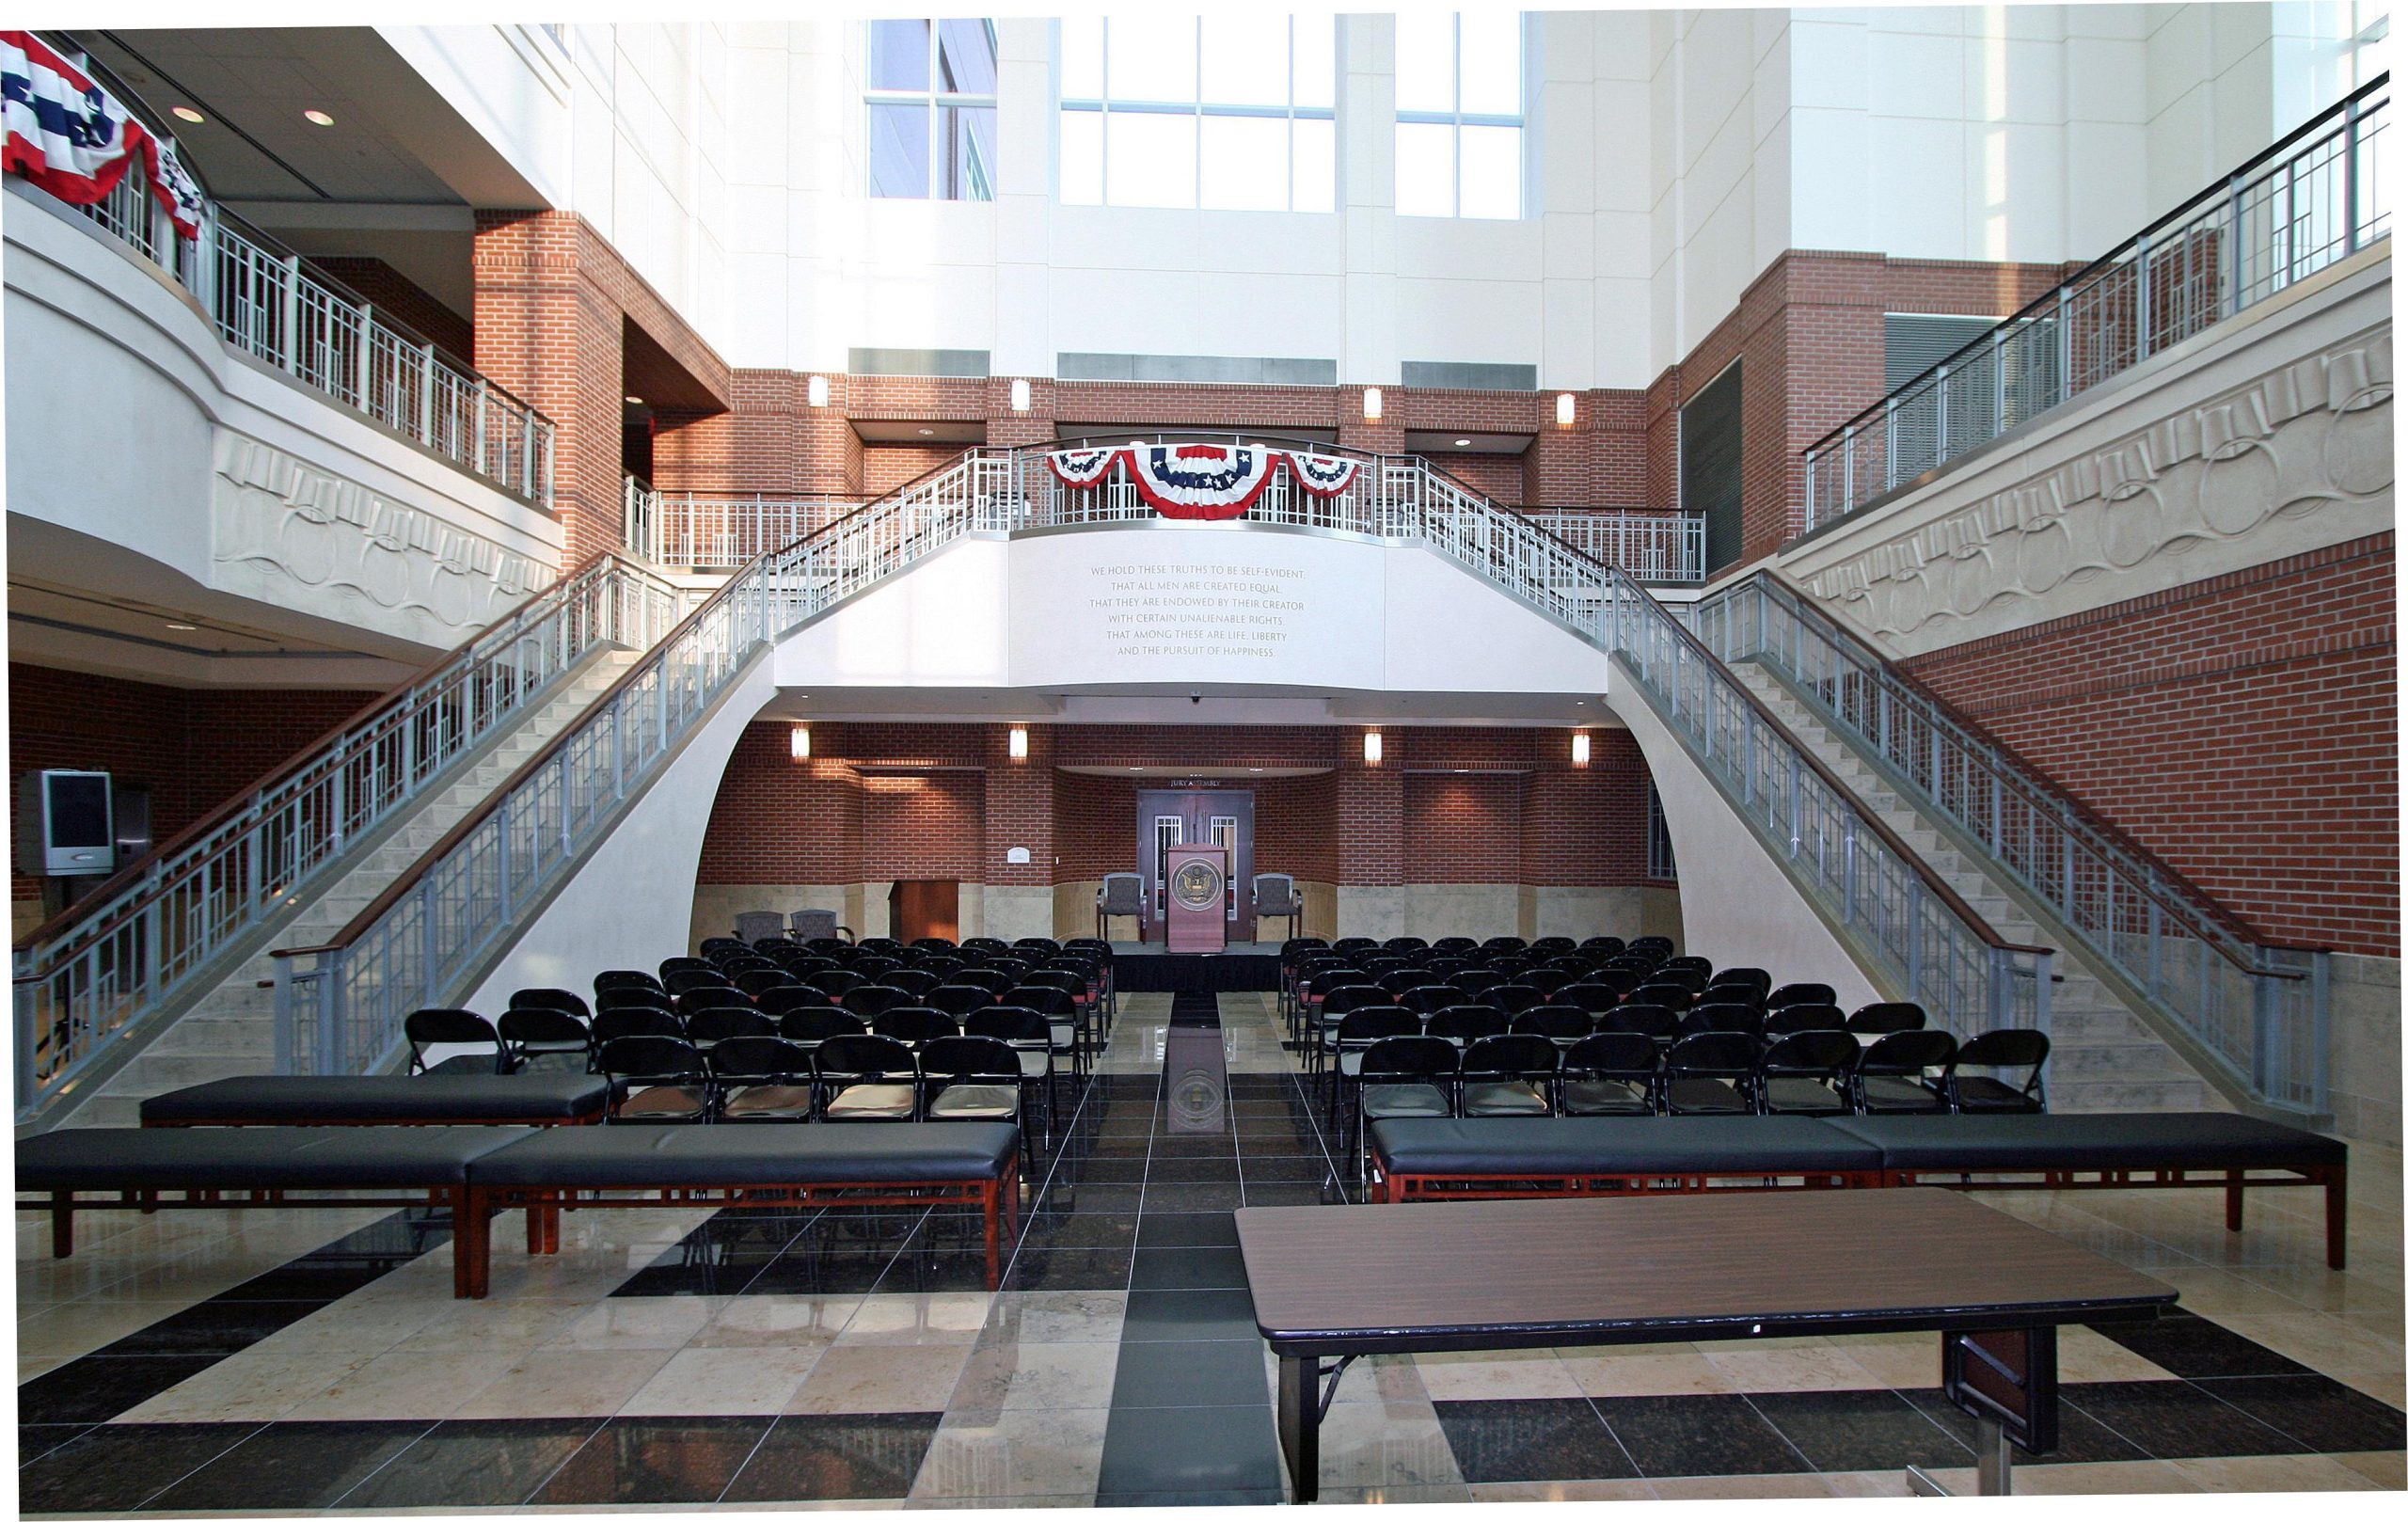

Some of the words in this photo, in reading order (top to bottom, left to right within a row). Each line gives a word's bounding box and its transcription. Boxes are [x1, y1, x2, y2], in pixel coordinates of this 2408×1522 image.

[1091, 567, 1104, 576] WE
[1108, 566, 1134, 575] HOLD
[1139, 565, 1166, 574] THESE
[1170, 565, 1207, 574] TRUTHS
[1211, 566, 1224, 575] TO
[1228, 566, 1237, 575] BE
[1111, 582, 1134, 591] THAT
[1183, 581, 1200, 590] ARE
[1204, 581, 1246, 591] CREATED
[1090, 599, 1113, 608] THAT
[1117, 598, 1139, 607] THEY
[1142, 598, 1159, 607] ARE
[1164, 597, 1213, 606] ENDOWED
[1218, 598, 1228, 607] BY
[1233, 599, 1259, 608] THEIR
[1262, 600, 1304, 610] CREATOR
[1108, 614, 1133, 623] WITH
[1180, 614, 1245, 623] UNALIENABLE
[1107, 630, 1130, 639] THAT
[1133, 630, 1172, 639] AMONG
[1175, 630, 1203, 639] THESE
[1207, 630, 1225, 639] ARE
[1252, 632, 1287, 642] LIBERTY
[1117, 646, 1138, 655] AND
[1142, 646, 1161, 655] THE
[1164, 646, 1204, 655] PURSUIT
[1207, 646, 1220, 655] OF
